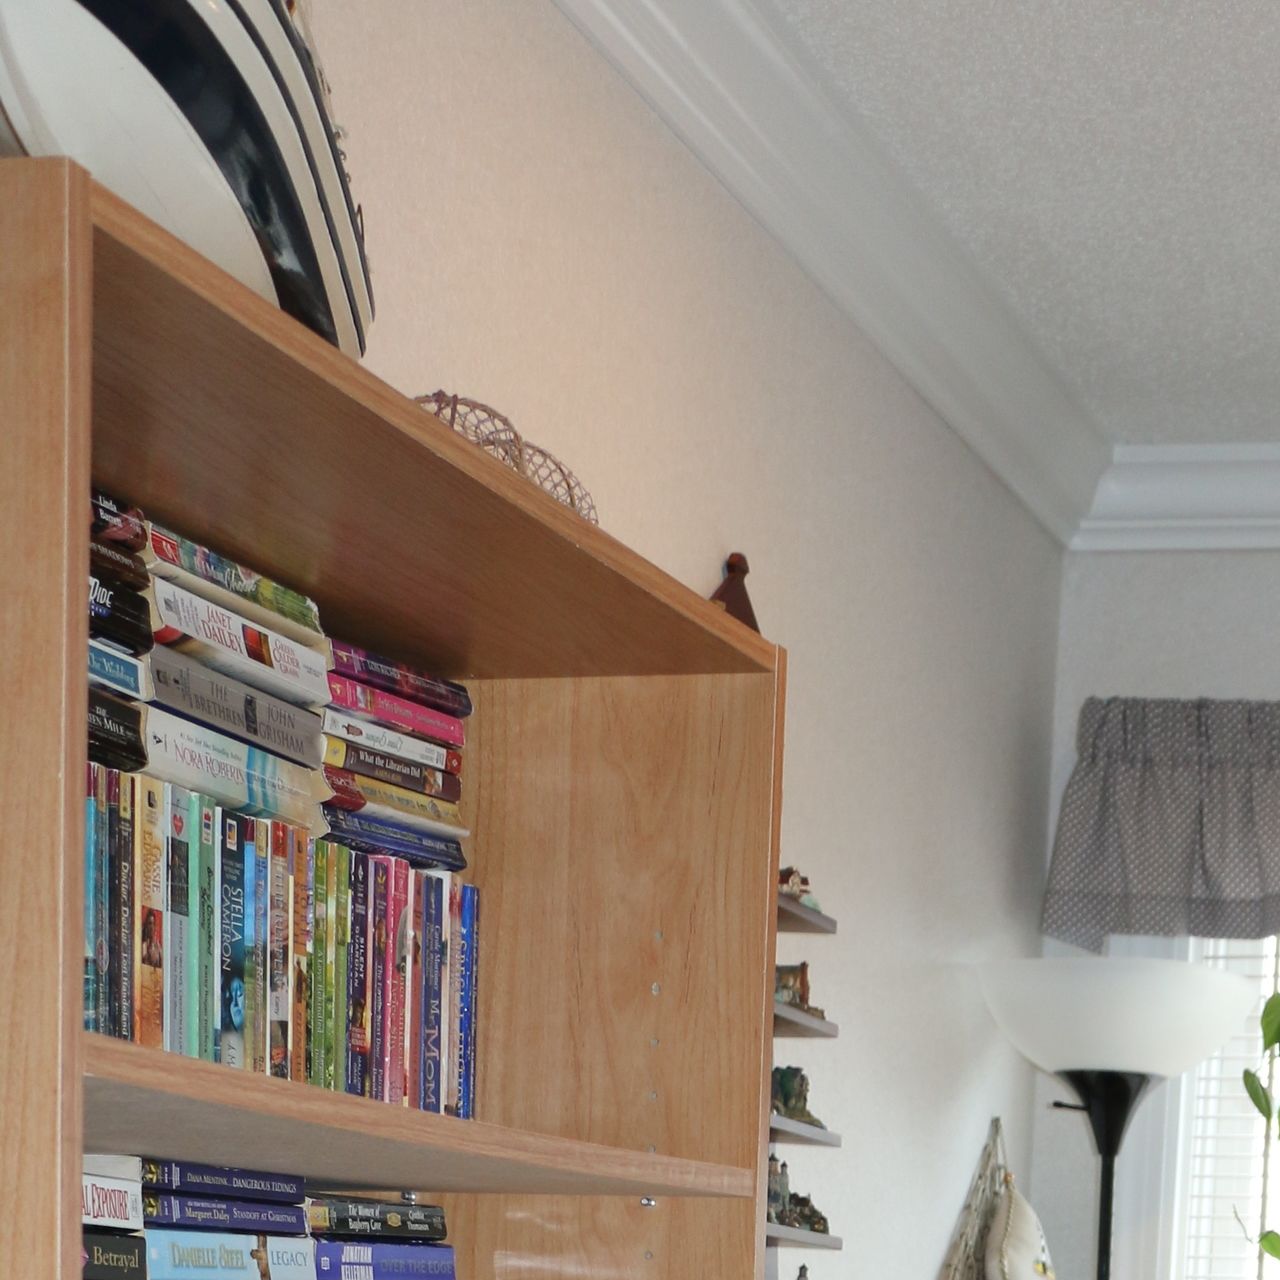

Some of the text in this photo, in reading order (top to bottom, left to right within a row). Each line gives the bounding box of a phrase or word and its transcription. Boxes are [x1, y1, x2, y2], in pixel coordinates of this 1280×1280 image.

[207, 606, 232, 631] JANET
[202, 618, 244, 655] DAILEY
[268, 704, 296, 729] JOHN
[222, 885, 231, 970] CAMERON
[231, 888, 243, 942] STELLA
[232, 1174, 297, 1193] DANGEROUS TIDINGS
[92, 1183, 130, 1221] EXPOSURE
[185, 1207, 212, 1221] Margaret
[213, 1210, 230, 1224] Daley
[93, 1246, 139, 1273] Betrayal
[170, 1242, 247, 1271] DANIELLE STEEL
[271, 1250, 309, 1268] LEGACY
